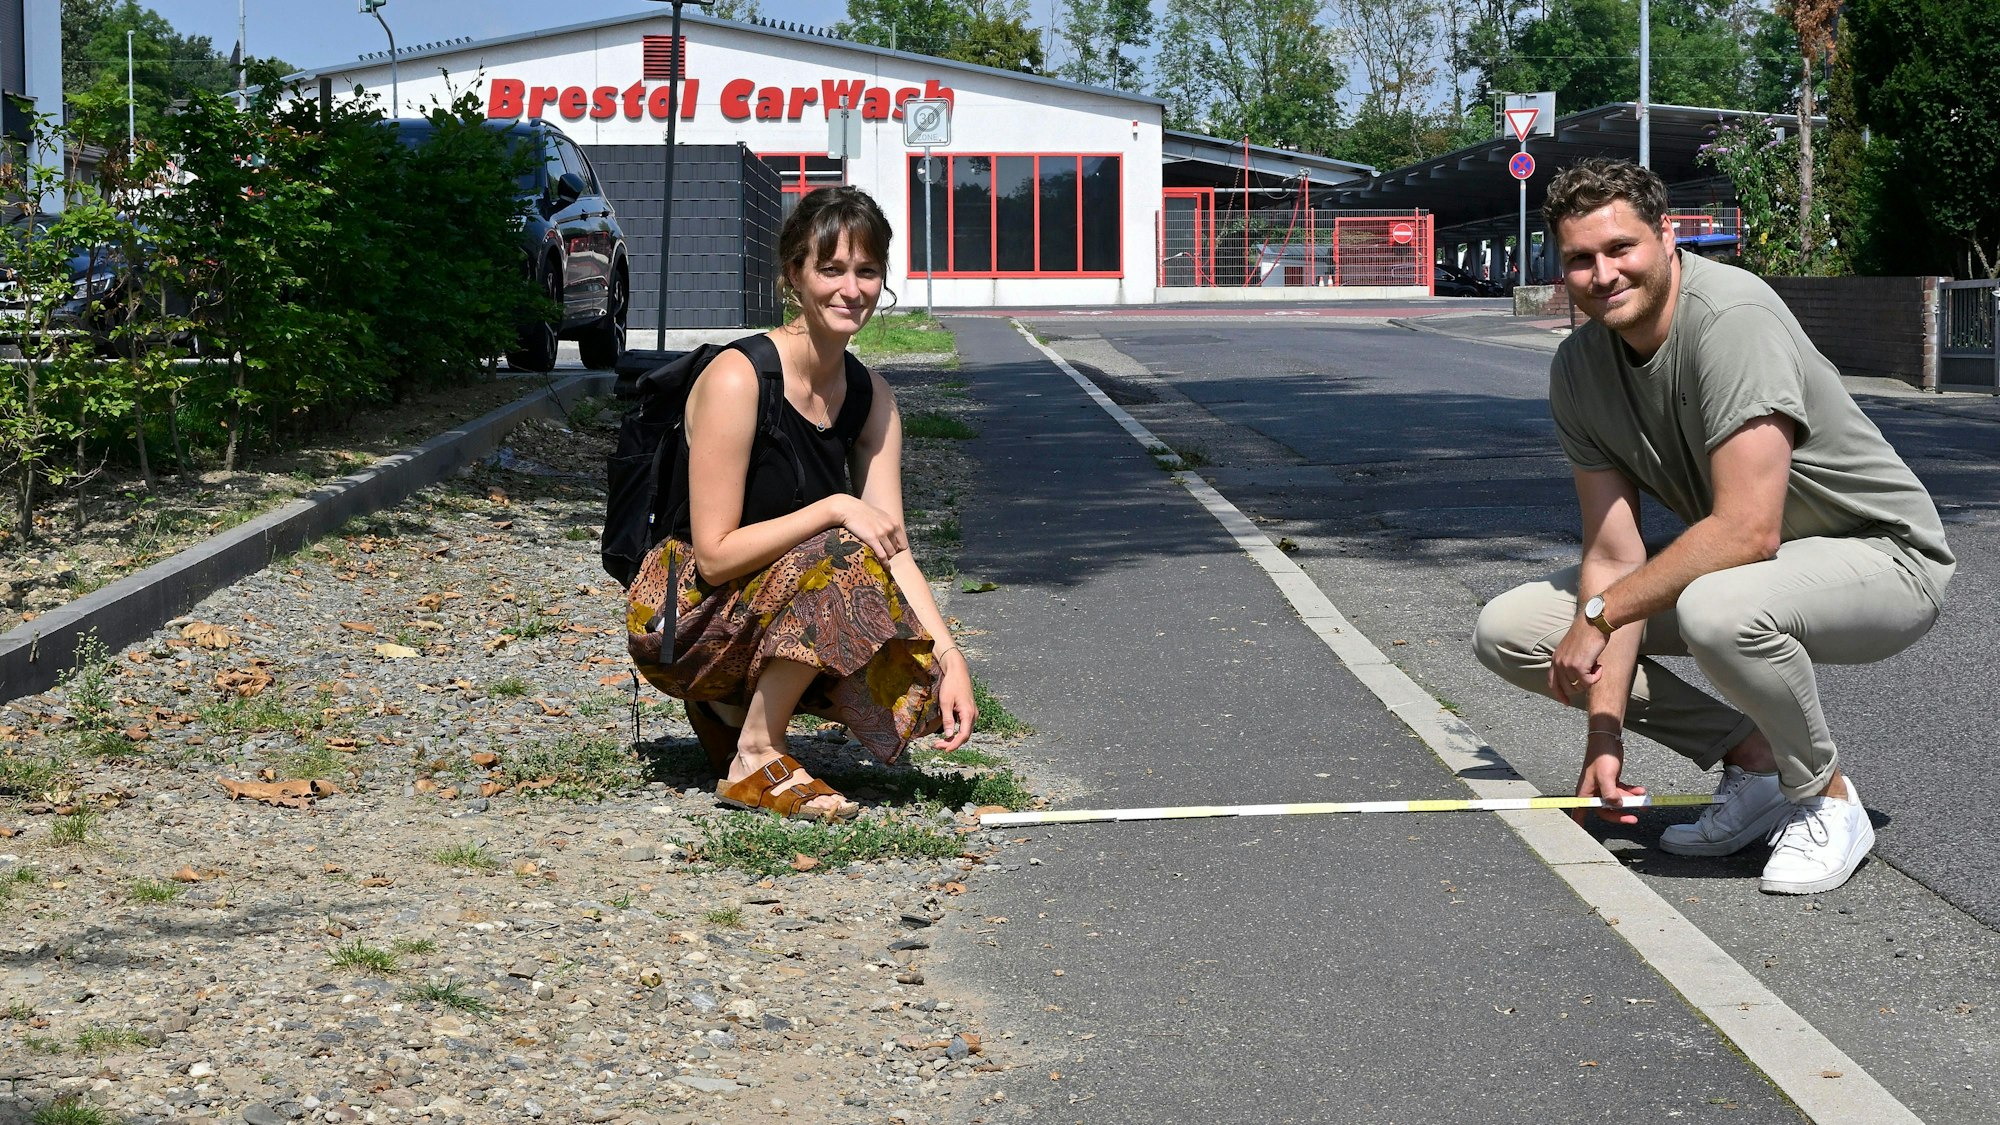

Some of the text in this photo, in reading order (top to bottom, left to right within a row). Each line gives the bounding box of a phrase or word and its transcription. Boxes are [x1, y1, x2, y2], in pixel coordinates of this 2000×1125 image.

[488, 78, 700, 120] Brestol
[919, 112, 934, 125] 30
[917, 133, 937, 141] ZONE
